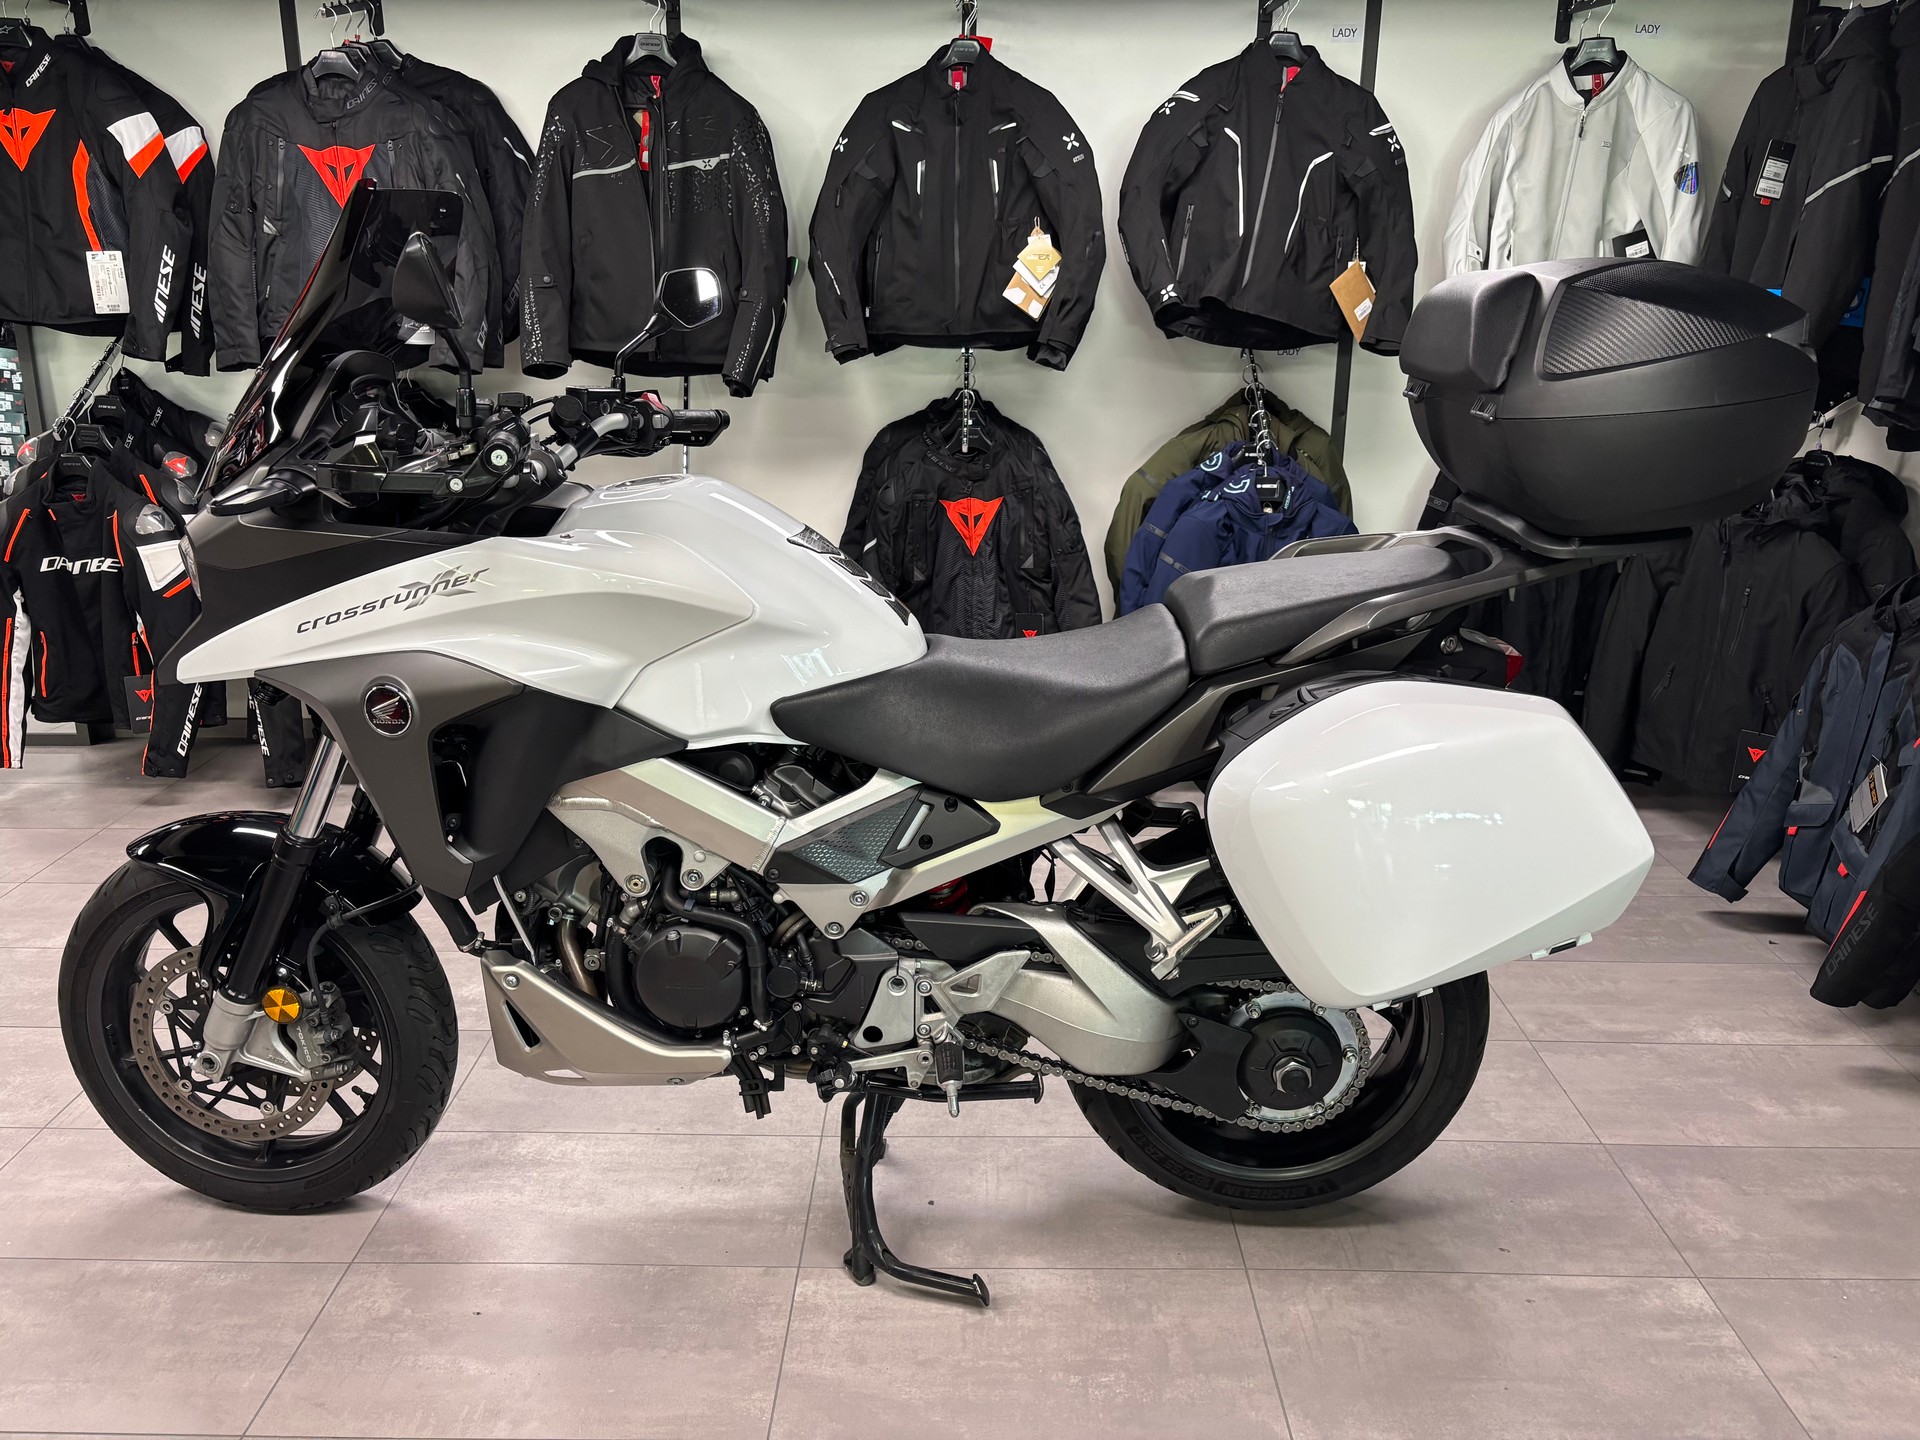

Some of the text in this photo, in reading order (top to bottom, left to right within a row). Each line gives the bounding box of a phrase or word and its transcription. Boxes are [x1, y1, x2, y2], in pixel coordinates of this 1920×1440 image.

[1332, 27, 1358, 38] LADY
[1635, 24, 1661, 34] LADY
[25, 53, 52, 88] DAINESE
[346, 78, 378, 110] DAINES
[296, 567, 491, 634] crossrunner
[176, 682, 204, 758] DAINESE
[372, 718, 406, 726] HONDA
[1825, 902, 1879, 978] DAINESE
[296, 1025, 312, 1063] TOKICO
[1221, 1183, 1307, 1200] MICHELIN
